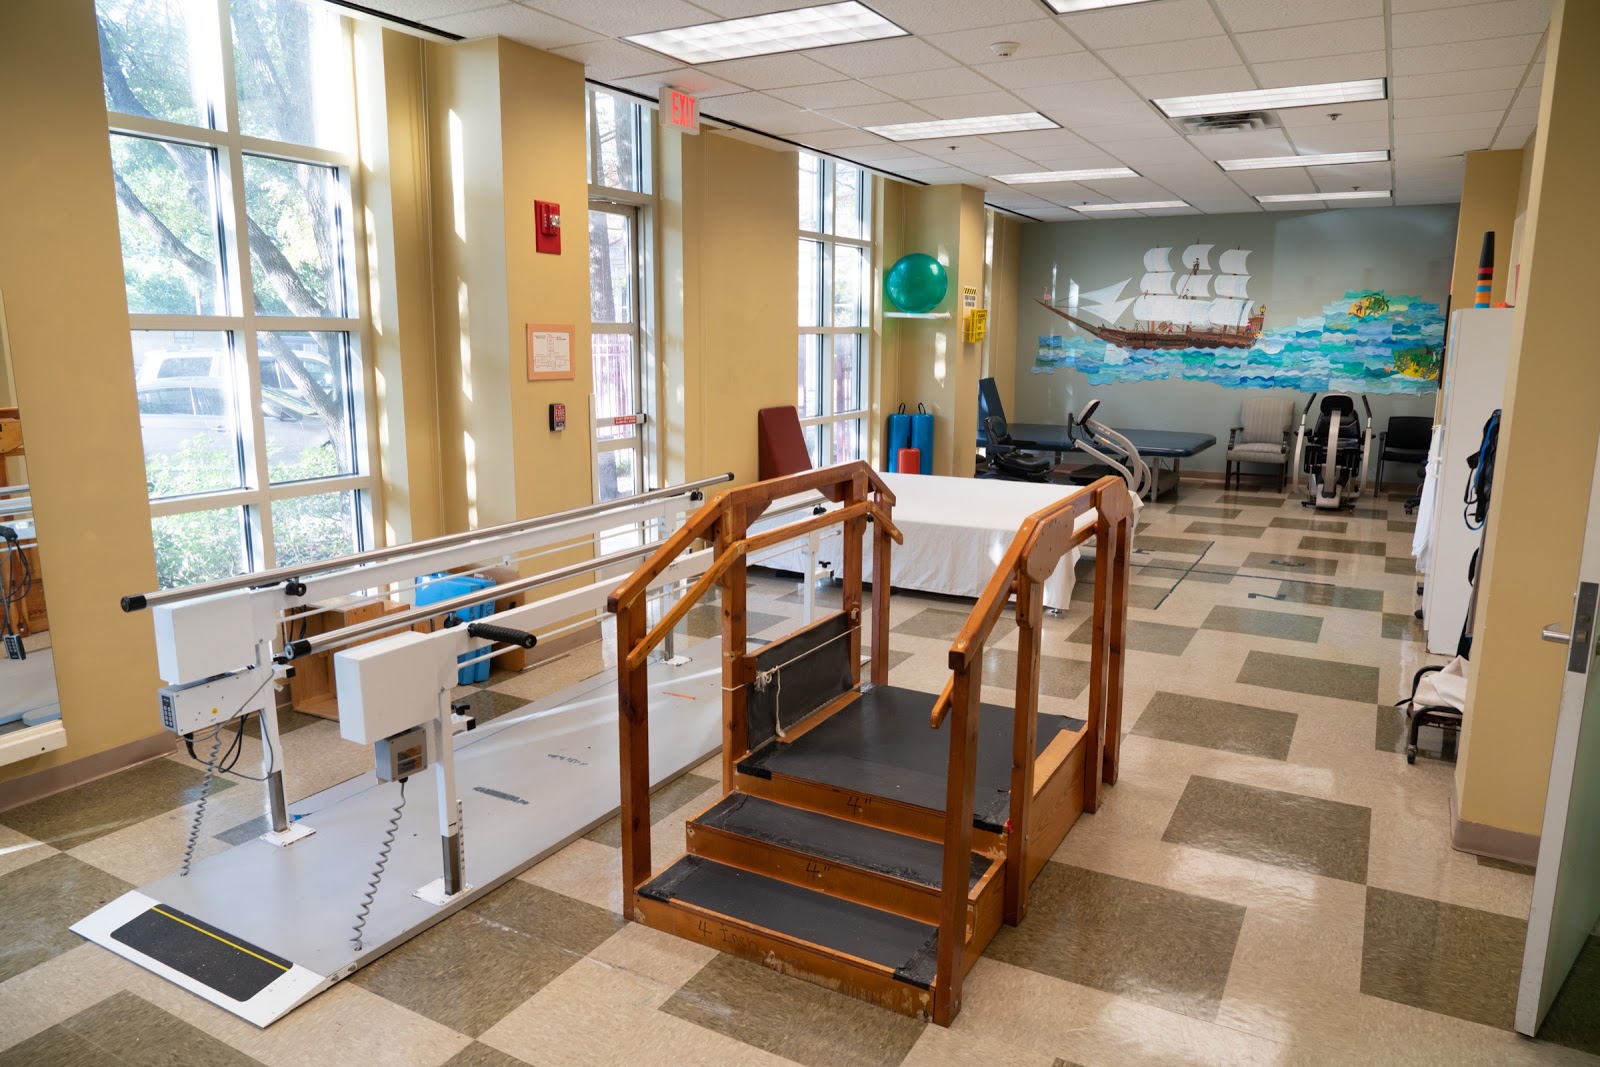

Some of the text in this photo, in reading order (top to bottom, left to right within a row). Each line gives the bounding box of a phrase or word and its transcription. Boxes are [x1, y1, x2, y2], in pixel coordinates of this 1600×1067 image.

[672, 91, 696, 129] EXIT
[555, 408, 565, 417] FIRE
[846, 797, 872, 815] 4"
[805, 862, 831, 881] 4"
[698, 921, 758, 949] 4 Inch
